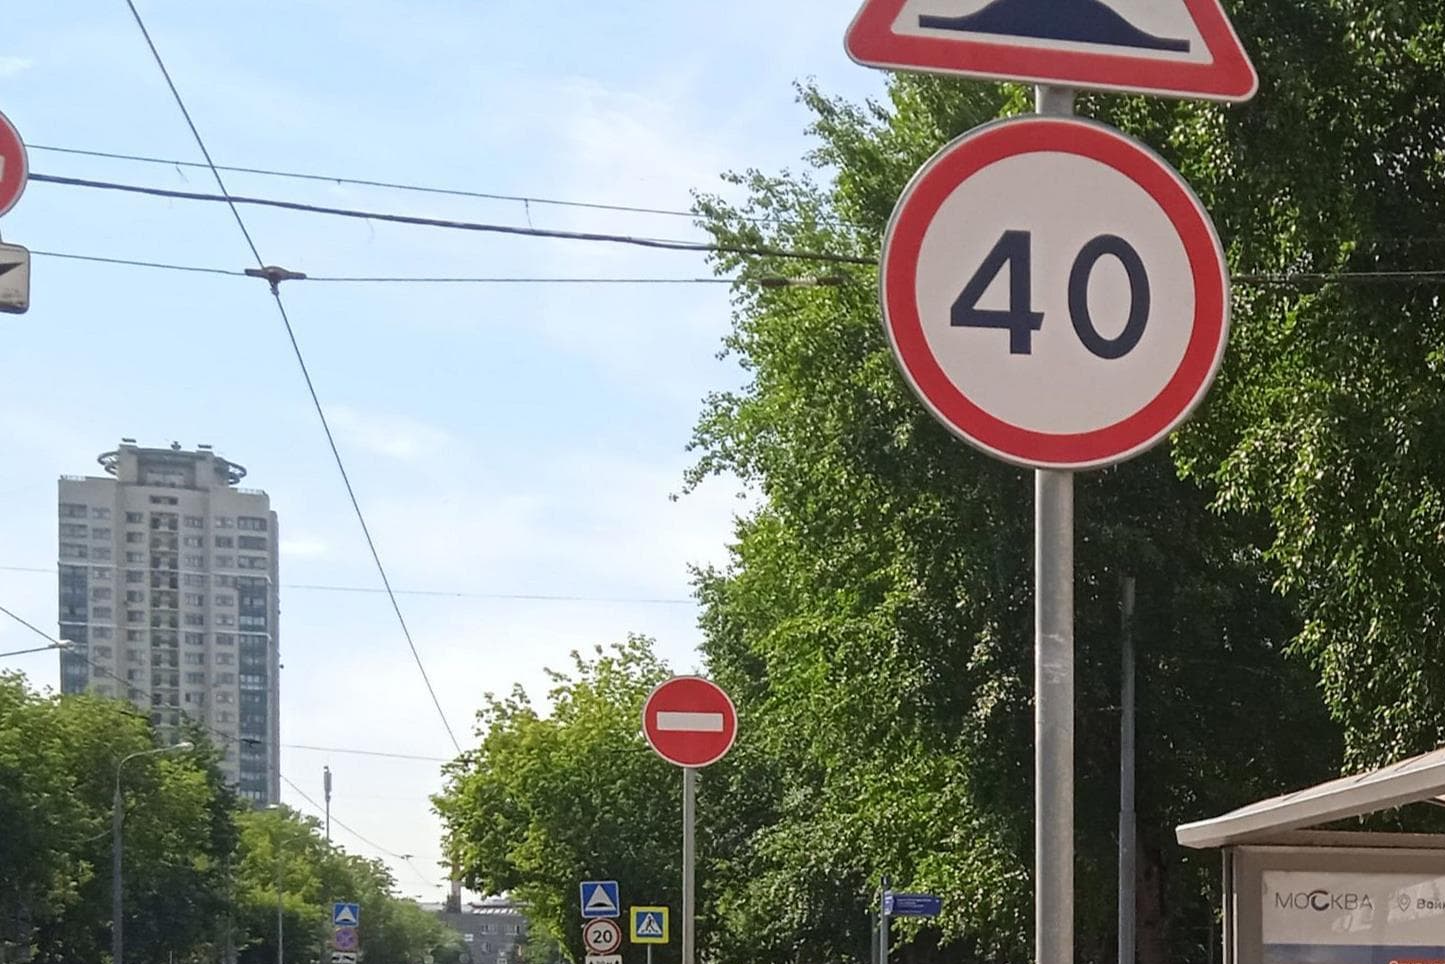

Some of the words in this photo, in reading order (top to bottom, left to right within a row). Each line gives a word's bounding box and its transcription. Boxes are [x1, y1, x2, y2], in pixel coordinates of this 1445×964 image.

[950, 229, 1151, 360] 40
[1275, 890, 1373, 911] МОСКВА
[593, 930, 612, 943] 20
